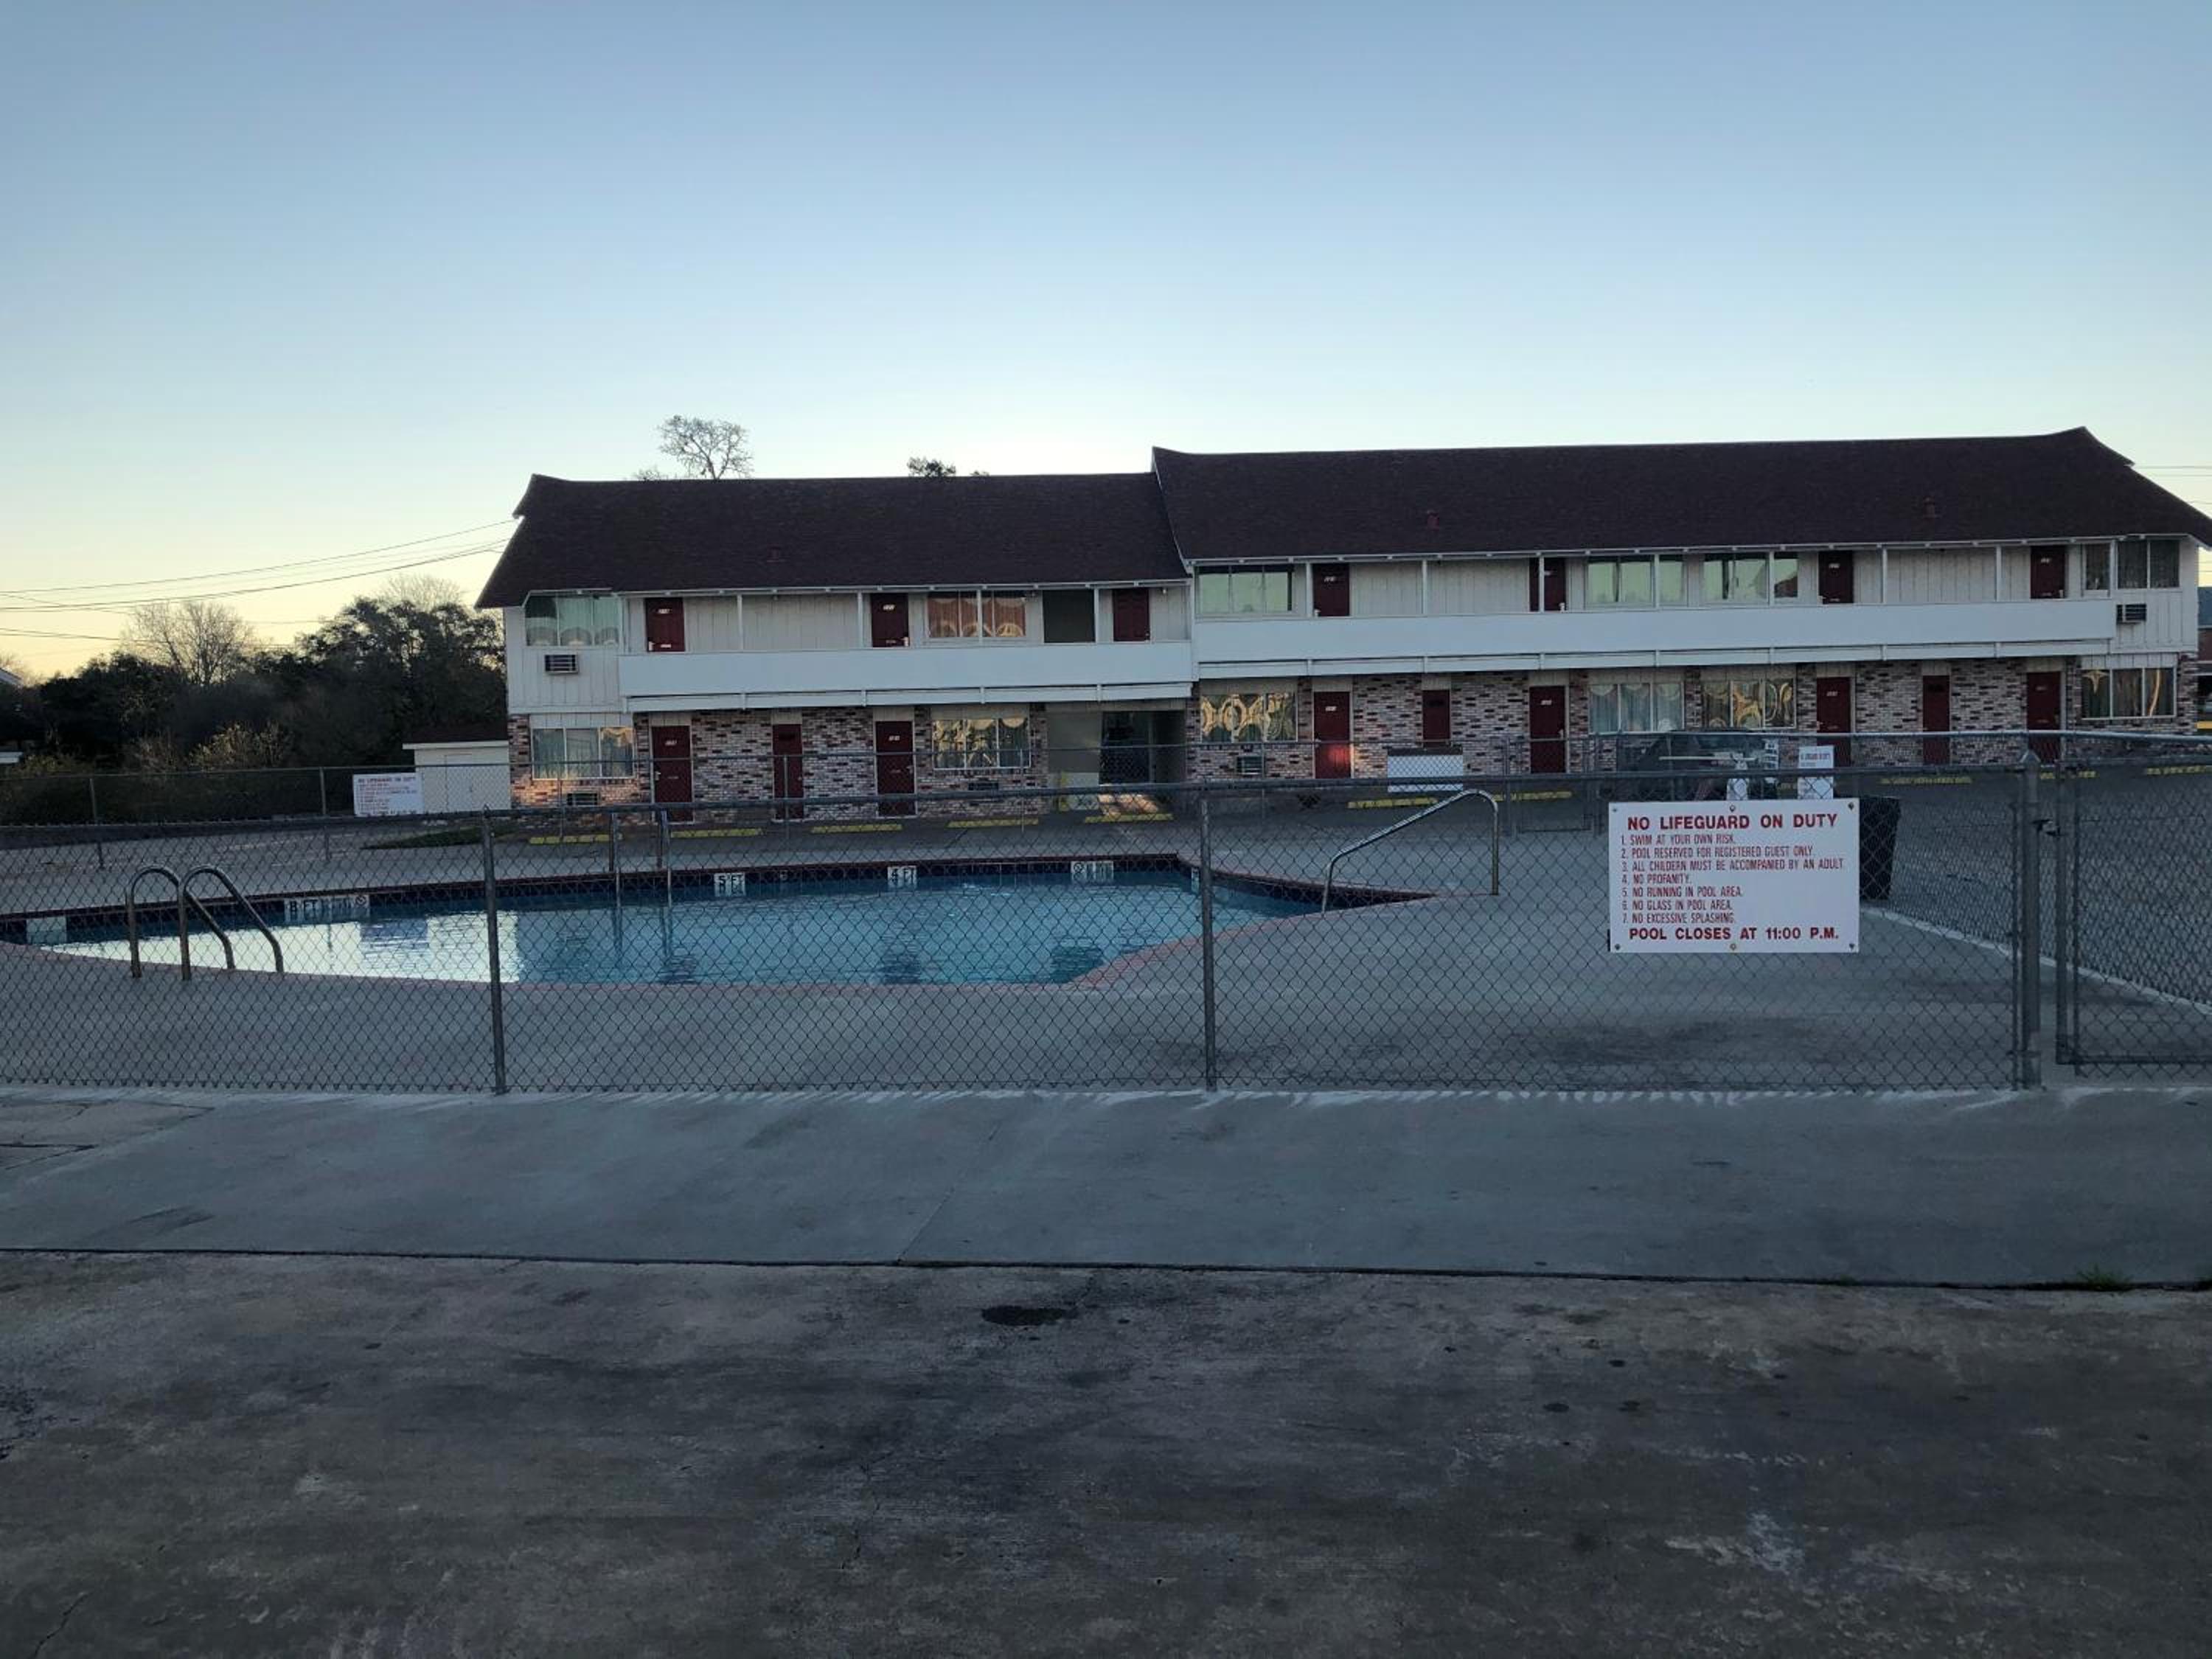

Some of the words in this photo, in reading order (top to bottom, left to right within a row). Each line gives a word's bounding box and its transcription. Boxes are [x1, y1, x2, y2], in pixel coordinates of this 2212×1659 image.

[1628, 817, 1649, 830] NO
[1660, 815, 1750, 830] LIFEGUARD
[1761, 814, 1783, 828] ON
[1793, 814, 1837, 827] DUTY
[1621, 835, 1627, 845] 1.
[1630, 834, 1652, 845] SWIM
[1656, 834, 1666, 845] AT
[1670, 834, 1691, 845] YOUR
[1694, 834, 1714, 844] OWN
[1621, 846, 1630, 859] 2.
[1632, 847, 1650, 859] POOL
[1654, 847, 1694, 858] RESERVED
[1697, 846, 1711, 858] FOR
[1714, 846, 1762, 858] REGISTERED
[1764, 846, 1790, 858] GUEST
[1632, 860, 1645, 872] ALL
[1649, 860, 1687, 872] CHILDERN
[1690, 860, 1712, 871] MUST
[1717, 860, 1725, 870] BE
[1730, 859, 1785, 870] ACCOMPANIED
[1789, 859, 1799, 870] BY
[1804, 859, 1815, 869] AN
[1632, 874, 1644, 885] NO
[1647, 873, 1691, 885] PROFANITY.
[1632, 886, 1644, 897] NO
[1647, 886, 1683, 897] RUNNING
[1686, 886, 1694, 897] IN
[1697, 886, 1717, 897] POOL
[1632, 900, 1644, 911] NO
[1647, 900, 1672, 911] GLASS
[1675, 900, 1683, 910] IN
[1687, 900, 1706, 911] POOL
[1711, 900, 1733, 911] AREA.
[1632, 913, 1644, 924] NO
[1646, 912, 1689, 924] EXCESSIVE
[1630, 928, 1667, 939] POOL
[1675, 928, 1731, 939] CLOSES
[1740, 928, 1757, 939] AT
[1765, 927, 1801, 939] 11:00
[1810, 928, 1838, 939] P.M.
